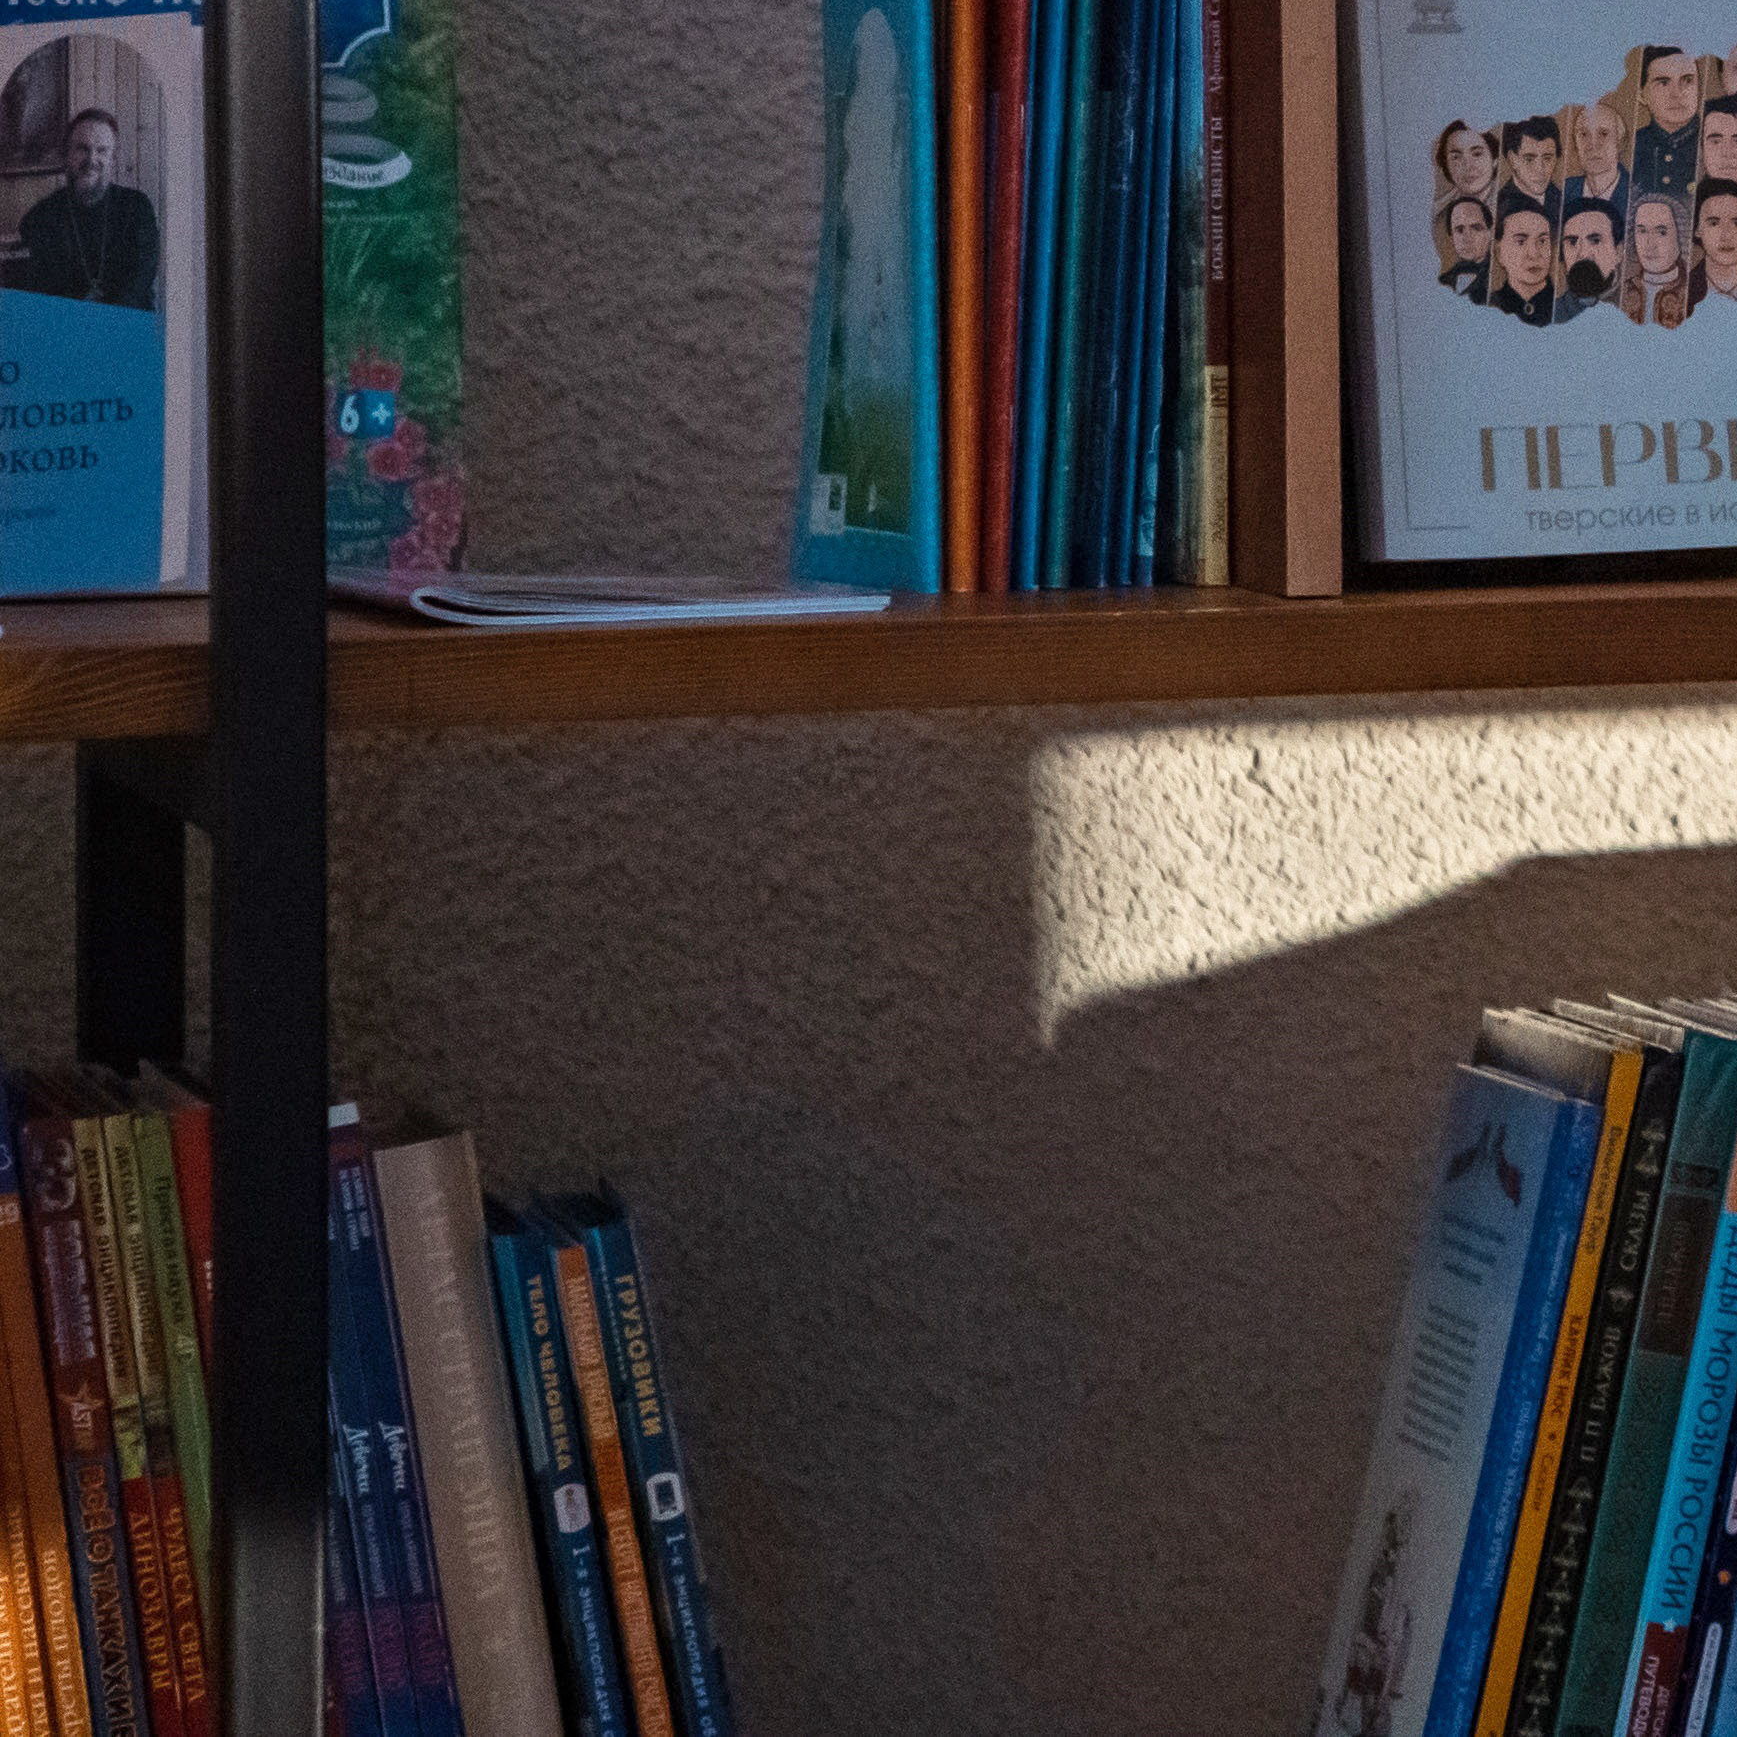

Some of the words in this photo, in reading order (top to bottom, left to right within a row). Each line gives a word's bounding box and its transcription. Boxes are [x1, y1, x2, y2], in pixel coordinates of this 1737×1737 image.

[1526, 504, 1676, 535] тверские
[524, 1273, 551, 1335] ТЕЛО
[609, 1272, 666, 1437] ГРУЗОВИКИ
[1587, 1326, 1625, 1412] БАЖОВ
[1617, 1189, 1654, 1273] СКАЗЫ
[535, 1339, 574, 1471] ЧЕЛОВЕКА
[1688, 1327, 1737, 1468] МОРОЗЫ
[36, 1547, 75, 1653] плодов
[122, 1505, 178, 1690] ДИНОЗАВРЫ
[159, 1504, 195, 1607] ЧУДЕСА
[1661, 1474, 1710, 1611] РОССИИ
[84, 1563, 135, 1697] ТАНКАХ
[174, 1619, 208, 1700] СВЕТА
